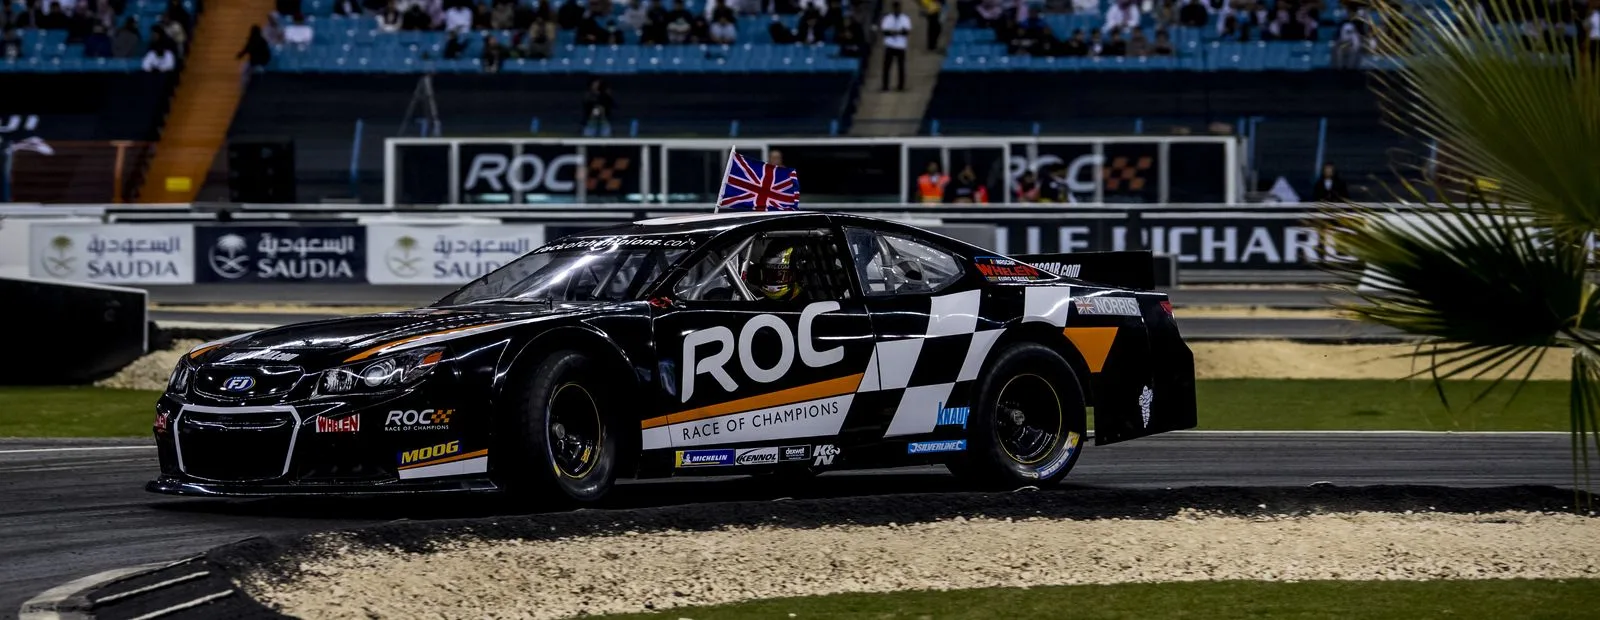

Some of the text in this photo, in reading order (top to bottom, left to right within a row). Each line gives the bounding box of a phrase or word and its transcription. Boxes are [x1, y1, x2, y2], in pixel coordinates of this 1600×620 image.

[464, 154, 584, 191] ROC
[87, 233, 180, 256] السعودية
[257, 233, 354, 257] السعودية
[87, 259, 178, 278] SAUDIA
[257, 258, 353, 278] SAUDIA
[975, 263, 1039, 276] WHELEN
[1094, 299, 1136, 314] NORRIS
[682, 301, 845, 403] ROC
[317, 414, 360, 432] WHELEN
[384, 409, 434, 425] ROC
[683, 401, 839, 440] RACE OF CHAMPIONS
[401, 440, 460, 464] MOOG
[692, 454, 728, 462] MICHELIN
[737, 454, 777, 463] KENNOL
